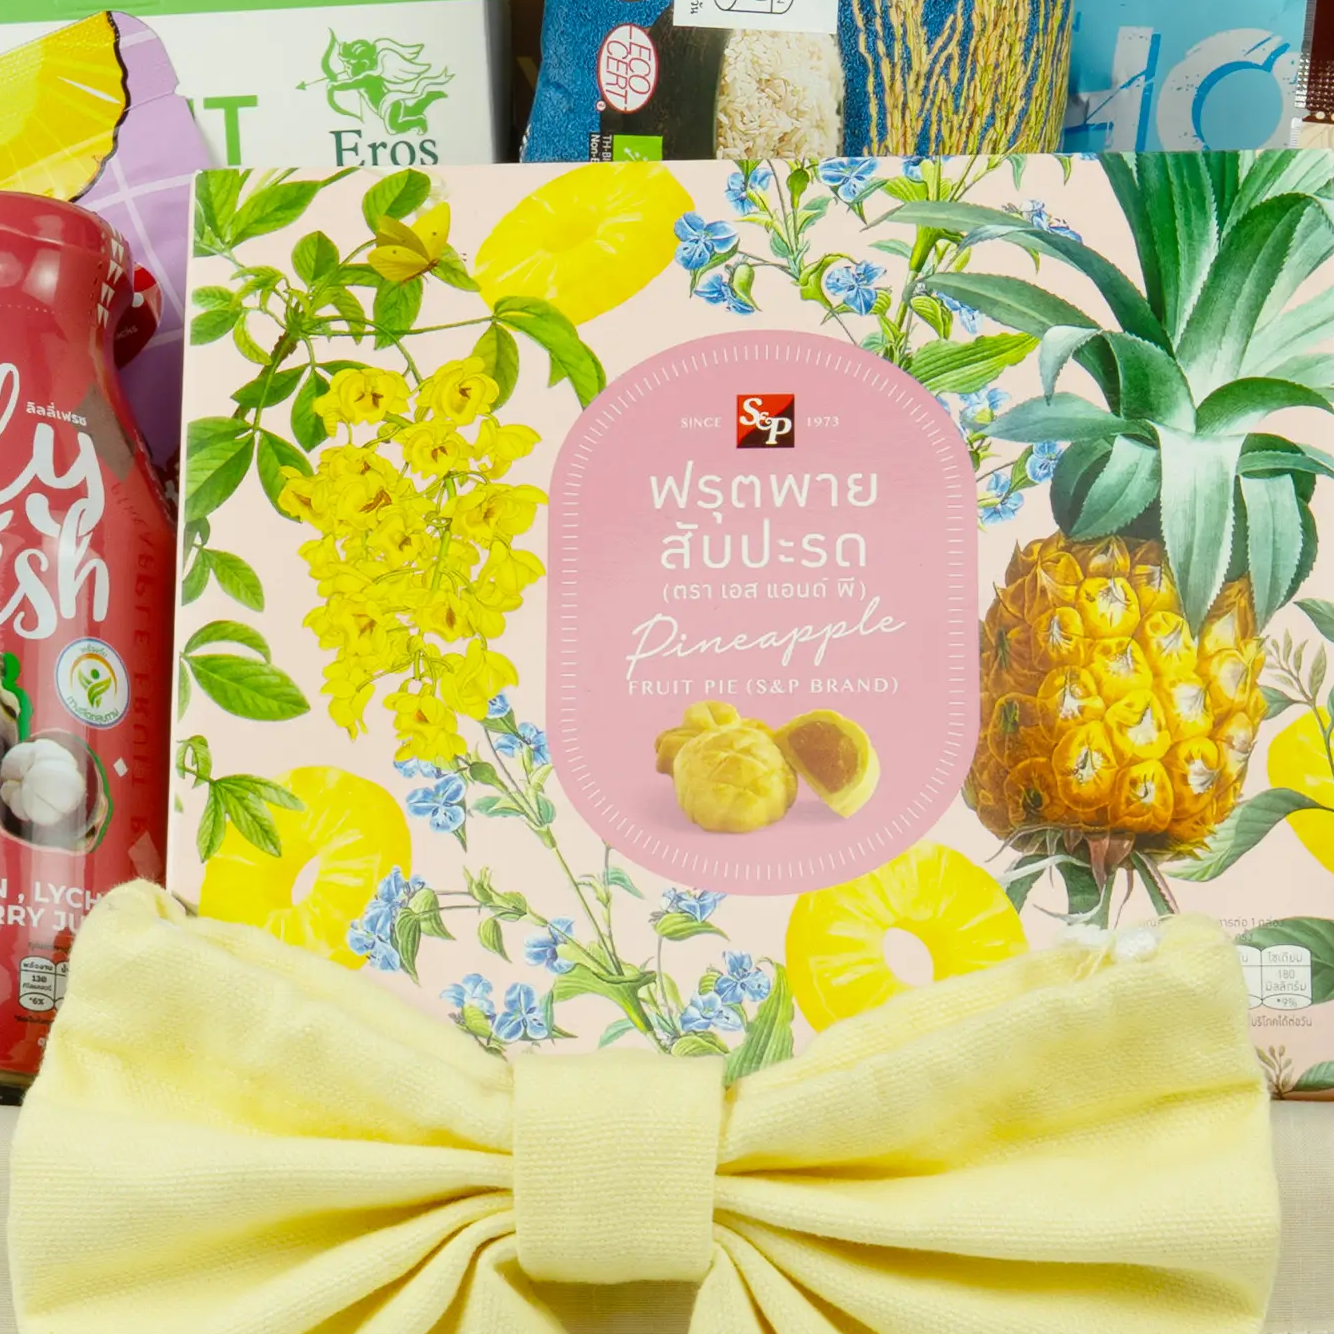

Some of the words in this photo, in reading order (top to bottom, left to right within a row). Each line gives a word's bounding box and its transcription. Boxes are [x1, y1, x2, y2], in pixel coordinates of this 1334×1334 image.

[606, 40, 627, 104] CERT
[629, 42, 651, 94] ECO
[329, 129, 439, 167] Eros
[681, 416, 722, 428] SINCE
[739, 397, 792, 445] S&P
[807, 416, 840, 428] 1973
[649, 460, 879, 523] ฟรุตพาย
[660, 518, 867, 569] สับปะรด
[663, 581, 713, 601] (ตรา
[721, 582, 758, 600] เอส
[767, 577, 827, 600] แอนด์
[626, 596, 907, 680] Pineapple
[629, 679, 694, 695] FRUIT
[705, 679, 738, 695] PIE
[746, 677, 800, 695] (S&P
[810, 677, 899, 695] BRAND)
[34, 881, 101, 910] LYCH
[1277, 969, 1296, 979] 180
